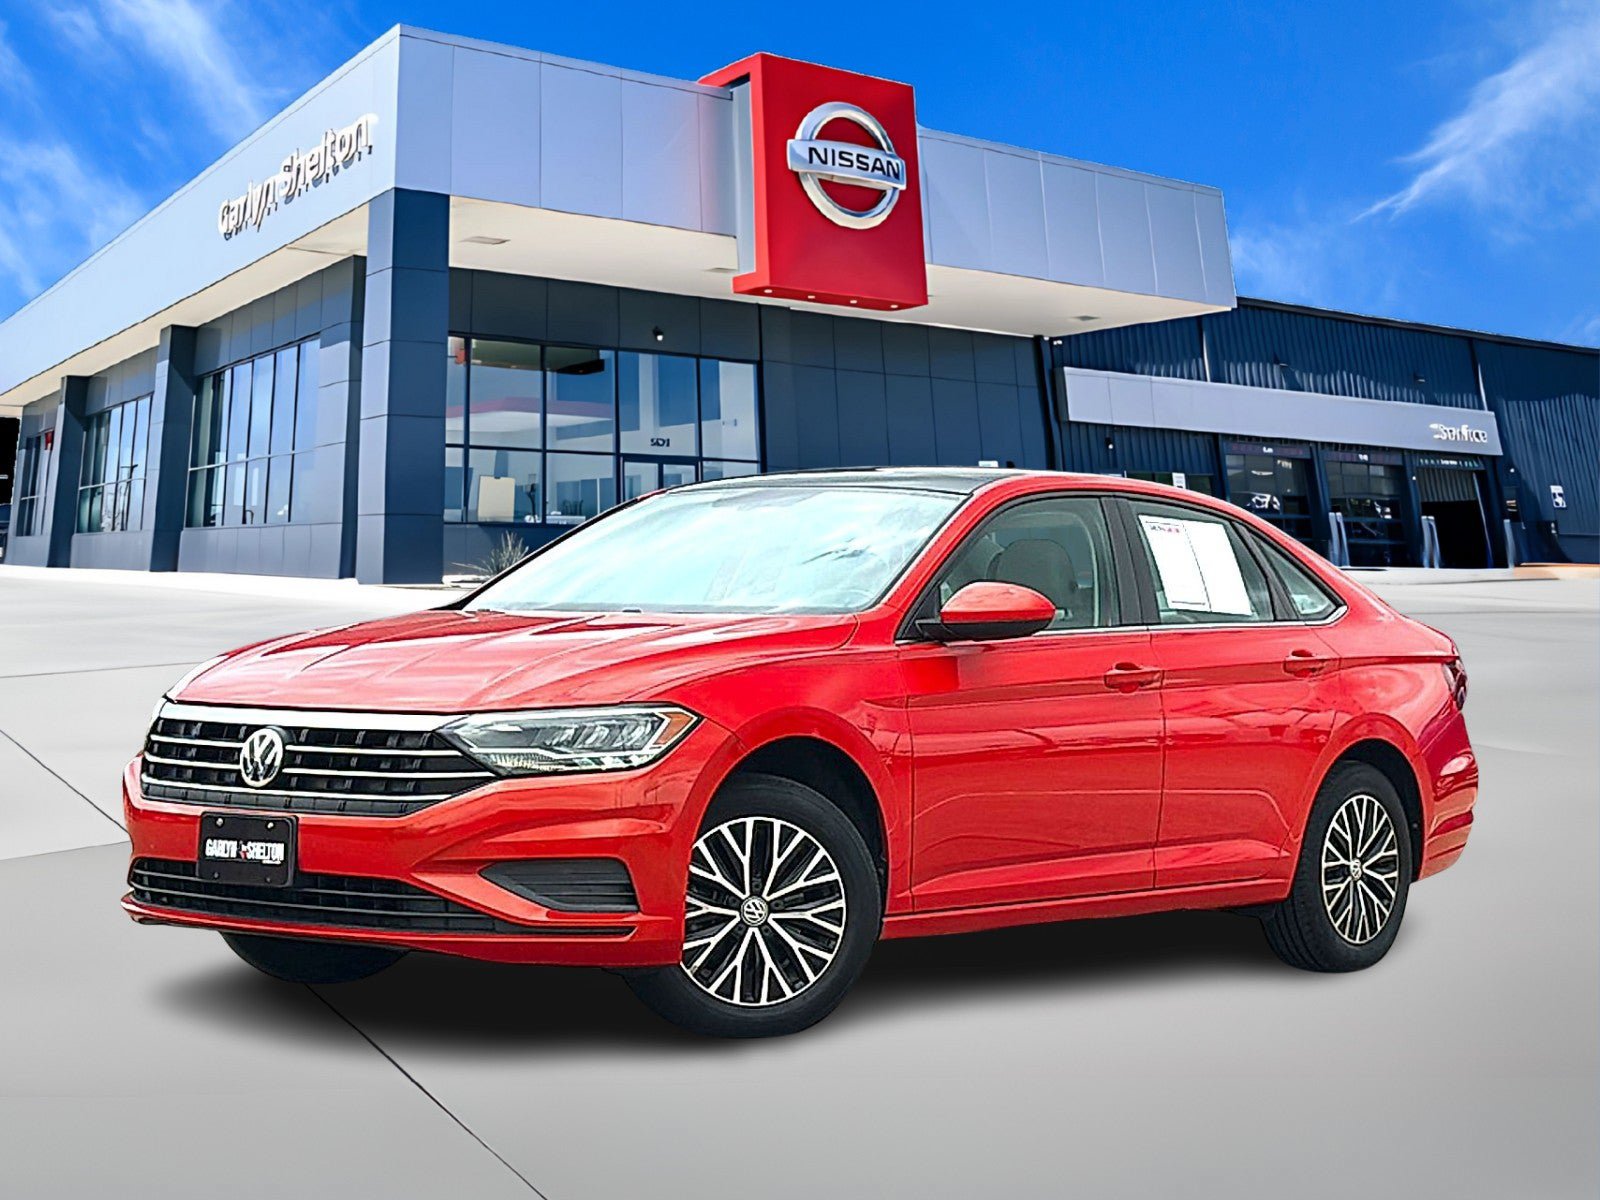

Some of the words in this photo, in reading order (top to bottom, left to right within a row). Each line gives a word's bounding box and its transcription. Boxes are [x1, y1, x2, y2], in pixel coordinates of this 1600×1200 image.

[279, 113, 377, 202] Shelton
[808, 147, 900, 180] NISSAN
[246, 841, 285, 861] SHELTON
